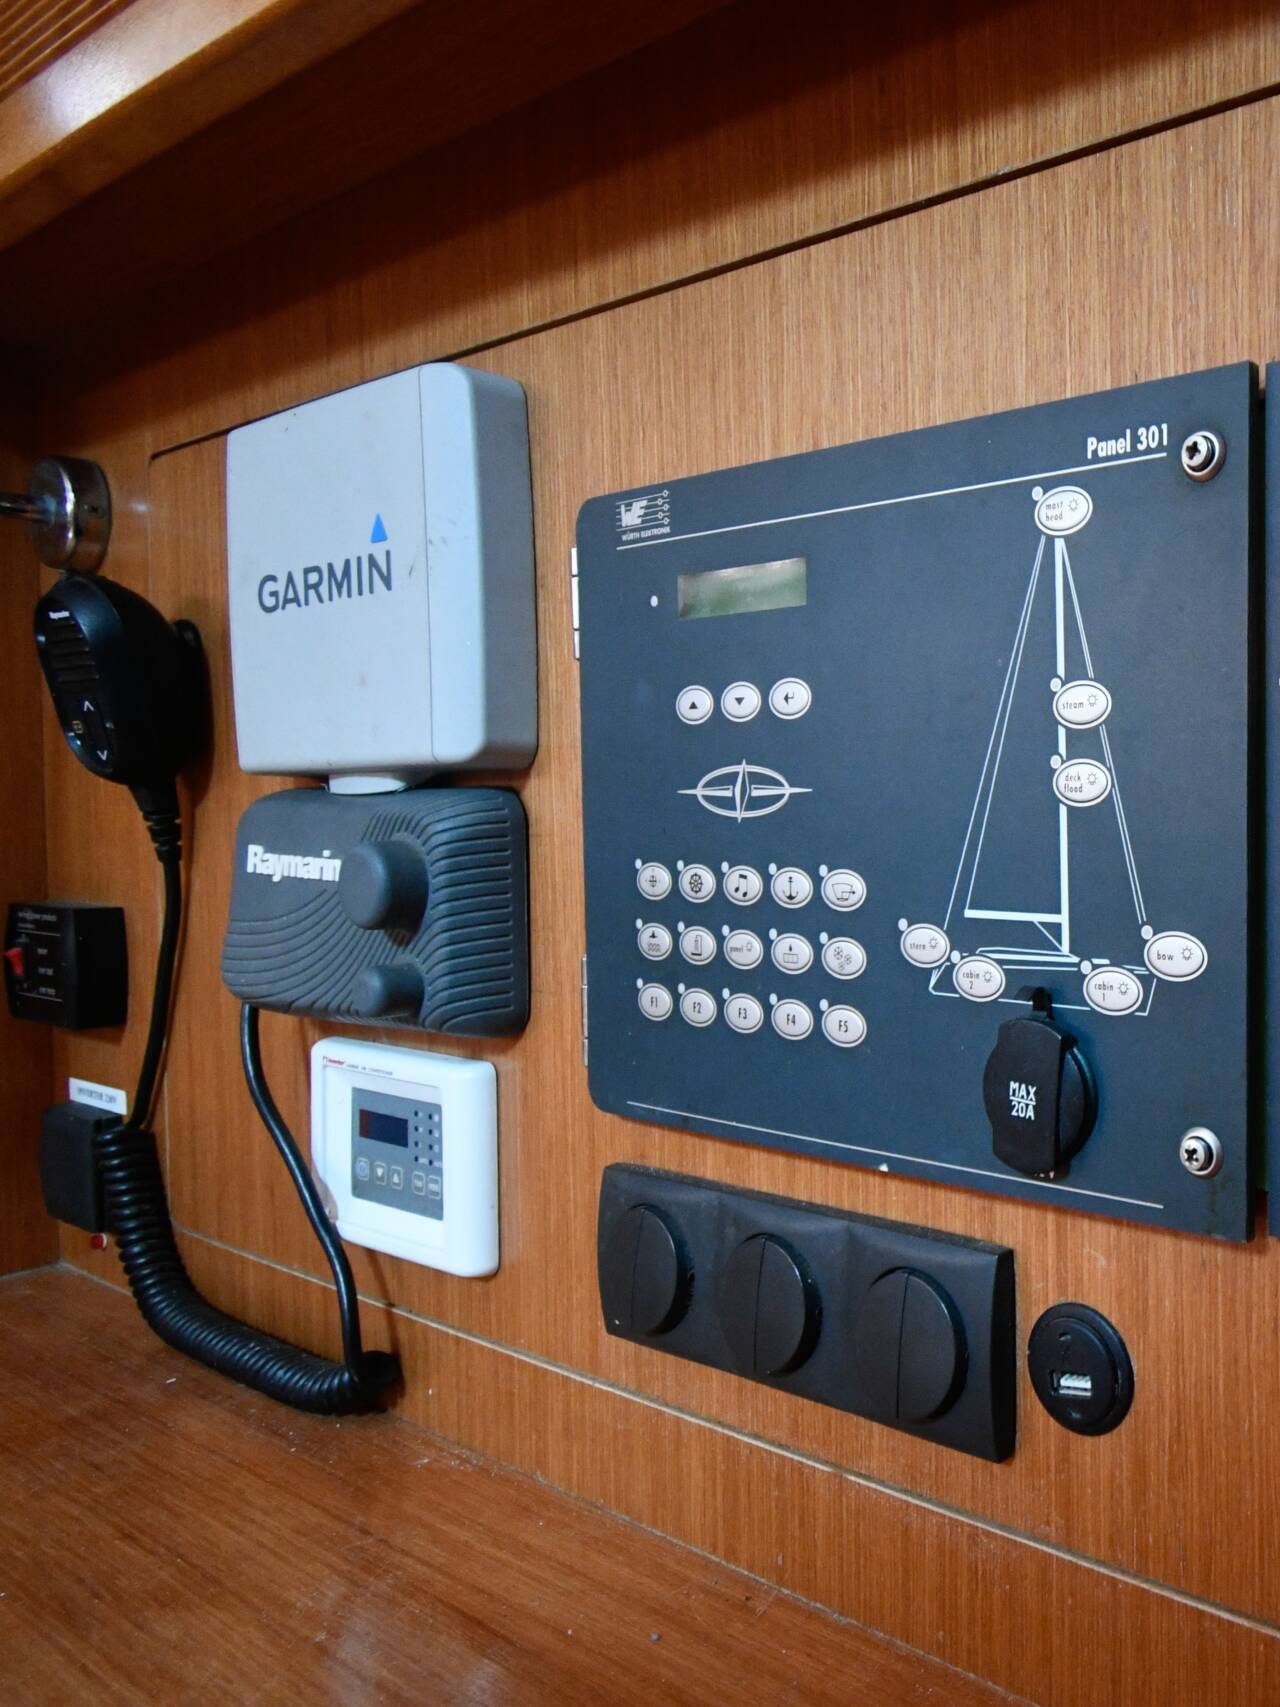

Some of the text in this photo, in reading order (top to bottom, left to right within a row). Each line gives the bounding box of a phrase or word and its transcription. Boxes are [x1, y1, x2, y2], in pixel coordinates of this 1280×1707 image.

[1086, 422, 1169, 460] Panel 301
[257, 550, 394, 614] GARMIN
[1062, 700, 1085, 710] steam
[1064, 773, 1082, 783] deck
[1063, 782, 1084, 794] flood
[246, 844, 342, 883] Raymarin
[1156, 950, 1174, 962] bow
[1094, 981, 1114, 992] cabin
[650, 996, 659, 1008] F1
[692, 1001, 702, 1015] F2
[738, 1007, 748, 1020] F3
[786, 1014, 796, 1026] F4
[838, 1020, 849, 1033] F5
[1009, 1081, 1037, 1101] MAX
[1010, 1101, 1036, 1121] 20A
